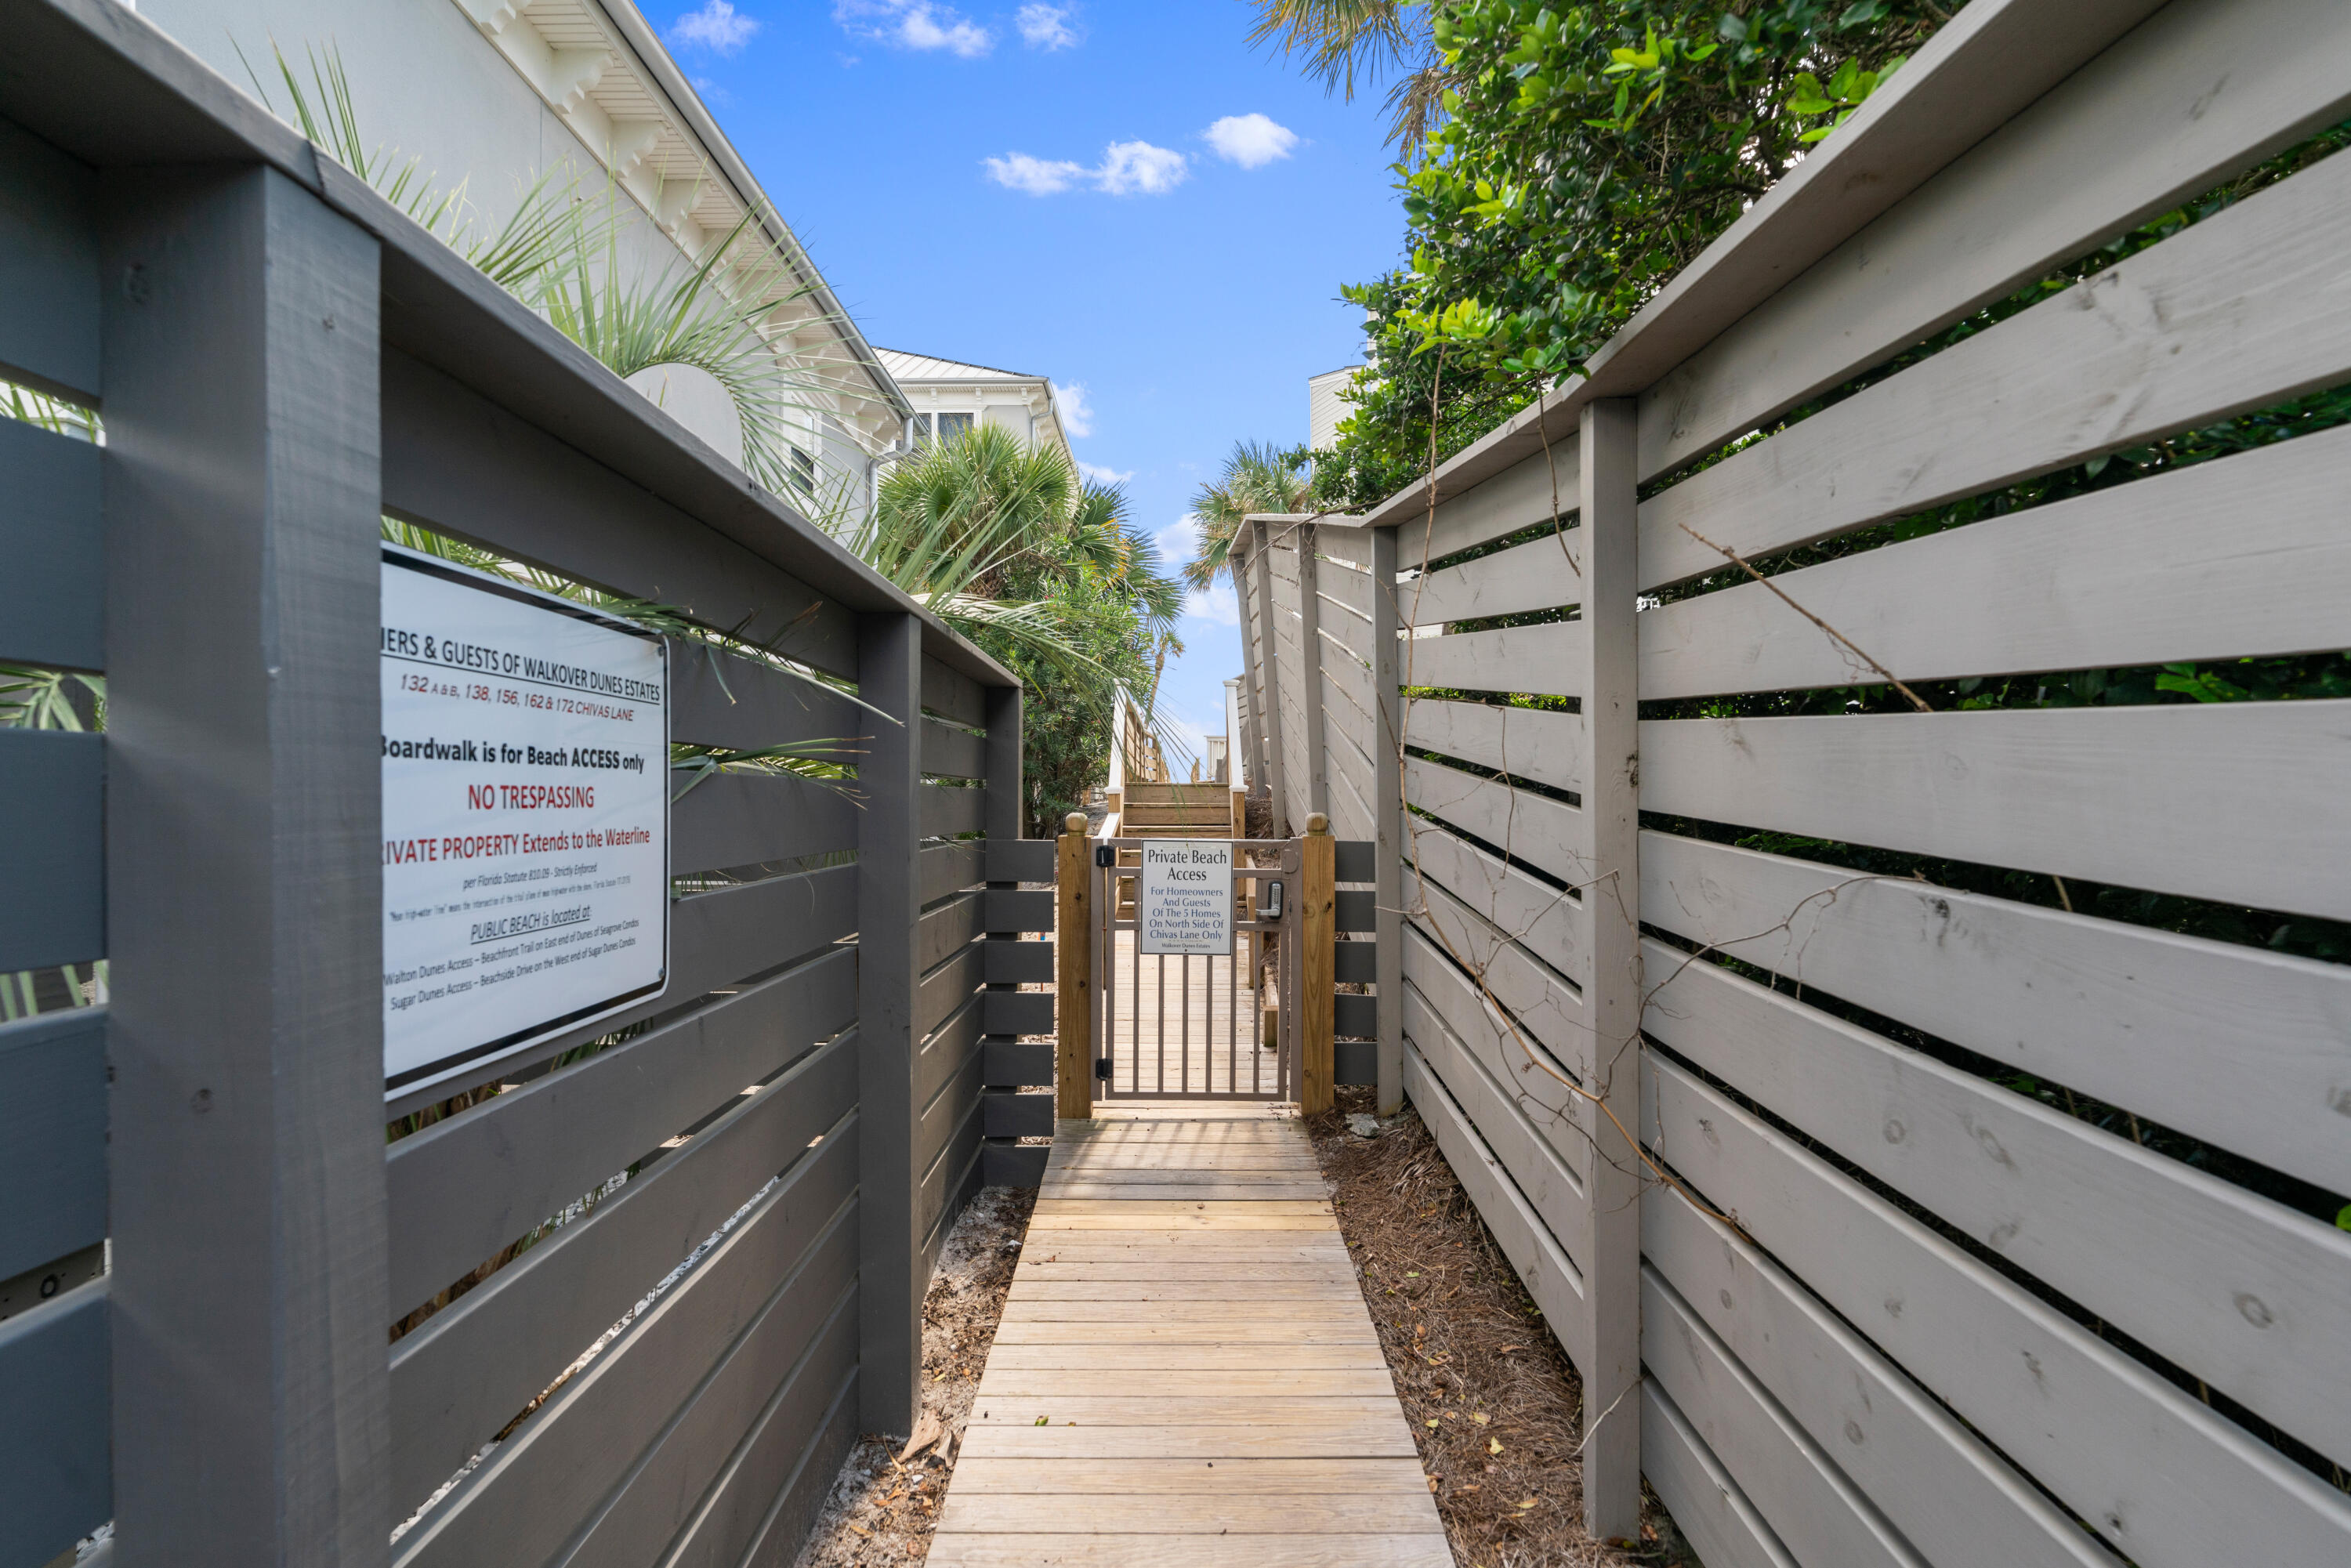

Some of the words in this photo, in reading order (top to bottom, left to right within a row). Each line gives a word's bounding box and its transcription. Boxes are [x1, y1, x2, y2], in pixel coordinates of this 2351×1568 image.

[424, 636, 437, 660] &
[443, 640, 499, 671] GUESTS
[502, 652, 520, 674] OF
[523, 657, 588, 687] WALKOVER
[590, 671, 623, 694] DUNES
[625, 679, 660, 701] ESTATES
[401, 674, 429, 693] 132
[466, 684, 491, 703] 138,
[497, 688, 520, 705] 156,
[524, 693, 544, 708] 162
[545, 696, 553, 710] &
[556, 698, 574, 713] 172
[576, 701, 609, 719] CHIVAS
[611, 707, 634, 722] LANE
[483, 741, 496, 762] is
[501, 743, 523, 764] for
[527, 746, 567, 766] Beach
[571, 747, 620, 769] ACCESS
[622, 754, 644, 774] only
[469, 784, 495, 809] NO
[500, 785, 594, 809] TRESPASSING
[382, 838, 437, 865] IVATE
[443, 834, 520, 860] PROPERTY
[523, 831, 569, 853] Extends
[572, 831, 583, 849] to
[586, 828, 603, 848] the
[606, 826, 650, 846] Waterline
[1148, 849, 1188, 864] Private
[1192, 849, 1226, 864] Beach
[462, 878, 476, 892] per
[477, 871, 502, 886] Florida
[503, 870, 527, 884] Statute
[554, 865, 573, 878] Strictly
[574, 863, 597, 876] Enforced
[1167, 867, 1207, 881] Access
[1150, 886, 1165, 896] For
[1167, 886, 1223, 896] Homeowners
[1163, 897, 1179, 907] And
[1183, 897, 1211, 907] Guests
[470, 918, 508, 940] PUBLIC
[509, 912, 542, 933] BEACH
[542, 911, 549, 926] is
[552, 904, 581, 925] located
[1149, 918, 1162, 928] On
[1165, 919, 1190, 928] North
[1192, 919, 1210, 929] Side
[1212, 919, 1224, 929] Of
[1152, 907, 1164, 917] Of
[1166, 908, 1181, 917] The
[1183, 909, 1189, 918] 5
[1191, 909, 1221, 918] Homes
[419, 962, 446, 979] Dunes
[447, 958, 473, 972] Access
[481, 945, 519, 964] Beachfront
[520, 940, 534, 954] Trail
[535, 942, 543, 951] on
[545, 938, 557, 949] East
[558, 934, 569, 945] end
[570, 931, 578, 942] of
[577, 930, 593, 941] Dunes
[594, 927, 600, 936] of
[600, 922, 621, 936] Seagrove
[622, 918, 639, 929] Condos
[1150, 929, 1177, 939] Chivas
[1180, 930, 1200, 939] Lane
[1202, 930, 1223, 942] Only
[390, 995, 416, 1010] Sugar
[418, 987, 444, 1003] Dunes
[447, 981, 473, 995] Access
[480, 968, 515, 987] Beachside
[516, 964, 533, 976] Drive
[534, 961, 542, 972] on
[544, 958, 553, 969] the
[555, 954, 570, 966] West
[571, 951, 581, 962] end
[581, 948, 589, 959] of
[589, 946, 603, 958] Sugar
[603, 942, 619, 953] Dunes
[619, 936, 636, 948] Condos
